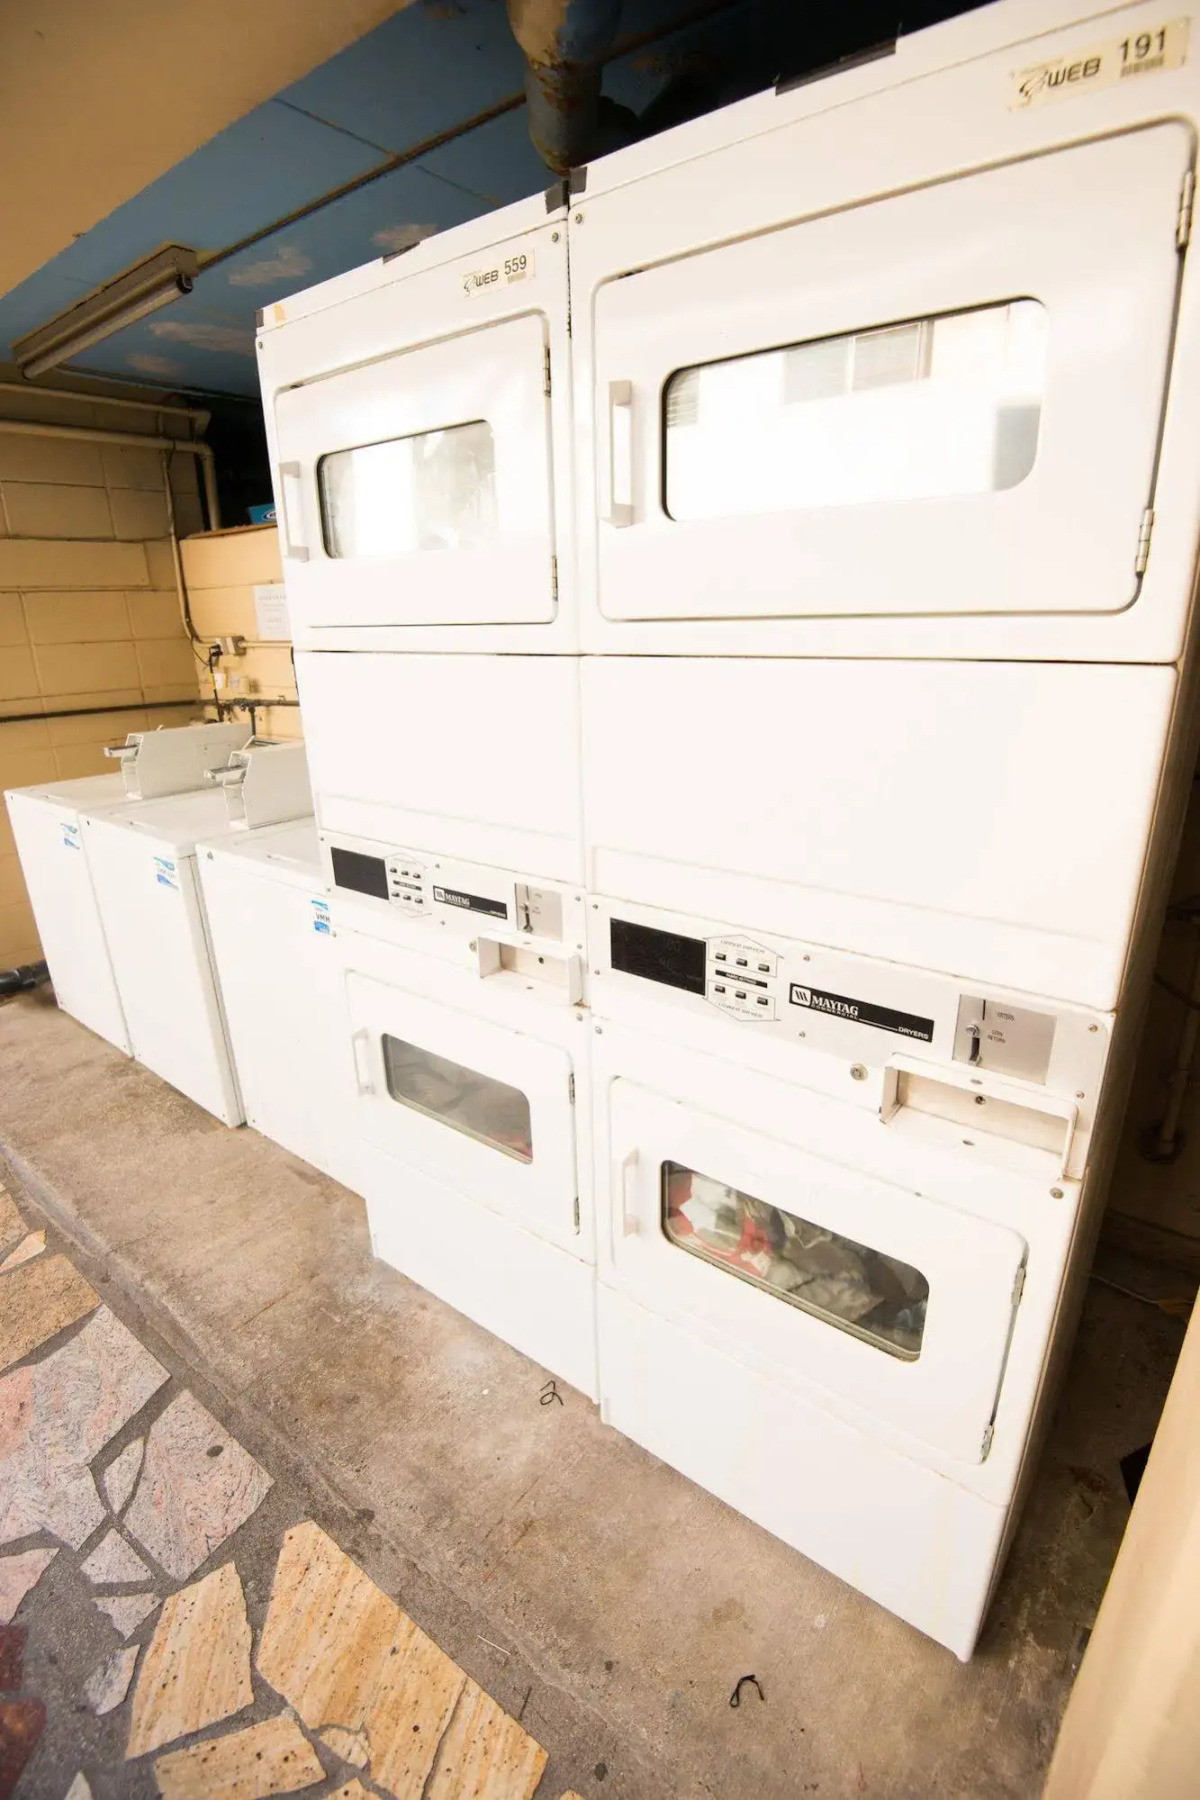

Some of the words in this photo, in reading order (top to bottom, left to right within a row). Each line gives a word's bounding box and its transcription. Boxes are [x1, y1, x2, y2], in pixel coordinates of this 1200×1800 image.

[1046, 57, 1102, 88] WEB
[1119, 25, 1168, 62] 191
[474, 269, 499, 288] WEB
[504, 254, 527, 275] 559
[811, 994, 860, 1017] MAYTAG
[897, 1026, 930, 1040] DRYERS
